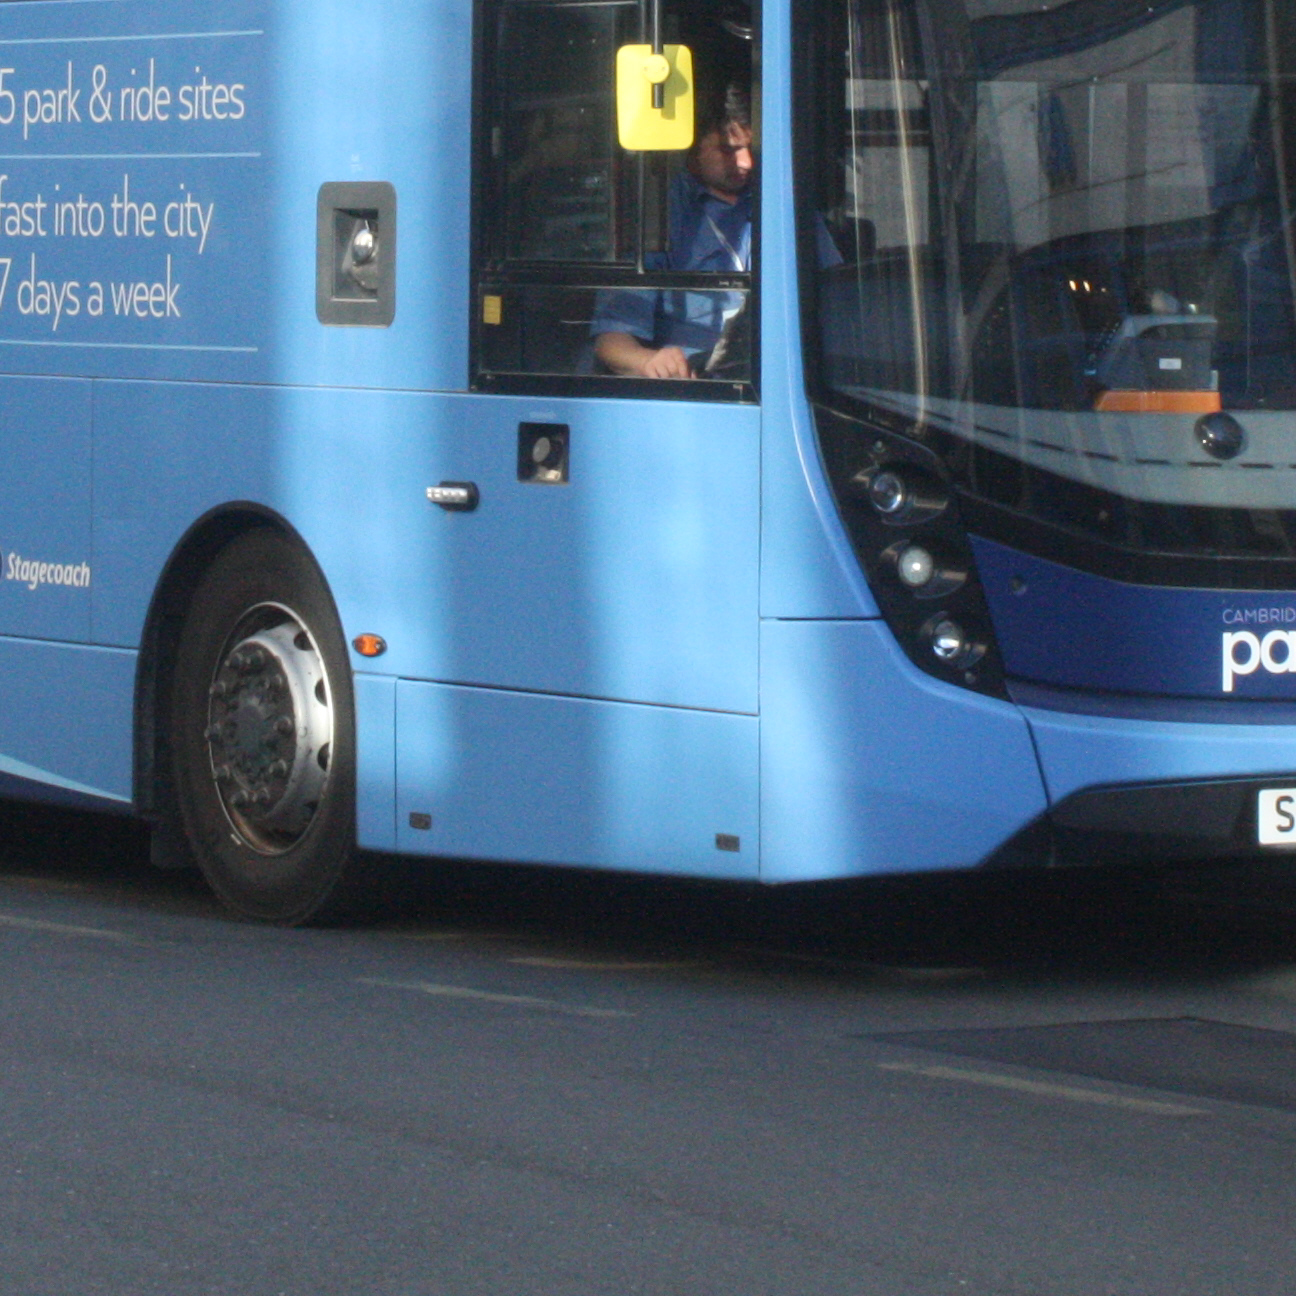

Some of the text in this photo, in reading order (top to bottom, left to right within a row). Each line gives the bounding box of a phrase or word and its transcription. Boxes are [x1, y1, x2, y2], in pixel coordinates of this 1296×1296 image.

[23, 60, 82, 141] park
[88, 64, 112, 123] &
[120, 57, 171, 122] ride
[179, 65, 246, 120] sites
[54, 184, 104, 237] into
[111, 173, 157, 237] the
[164, 183, 214, 254] city
[17, 252, 80, 332] days
[87, 281, 103, 316] a
[111, 254, 181, 318] week
[6, 552, 91, 590] Stagecoach
